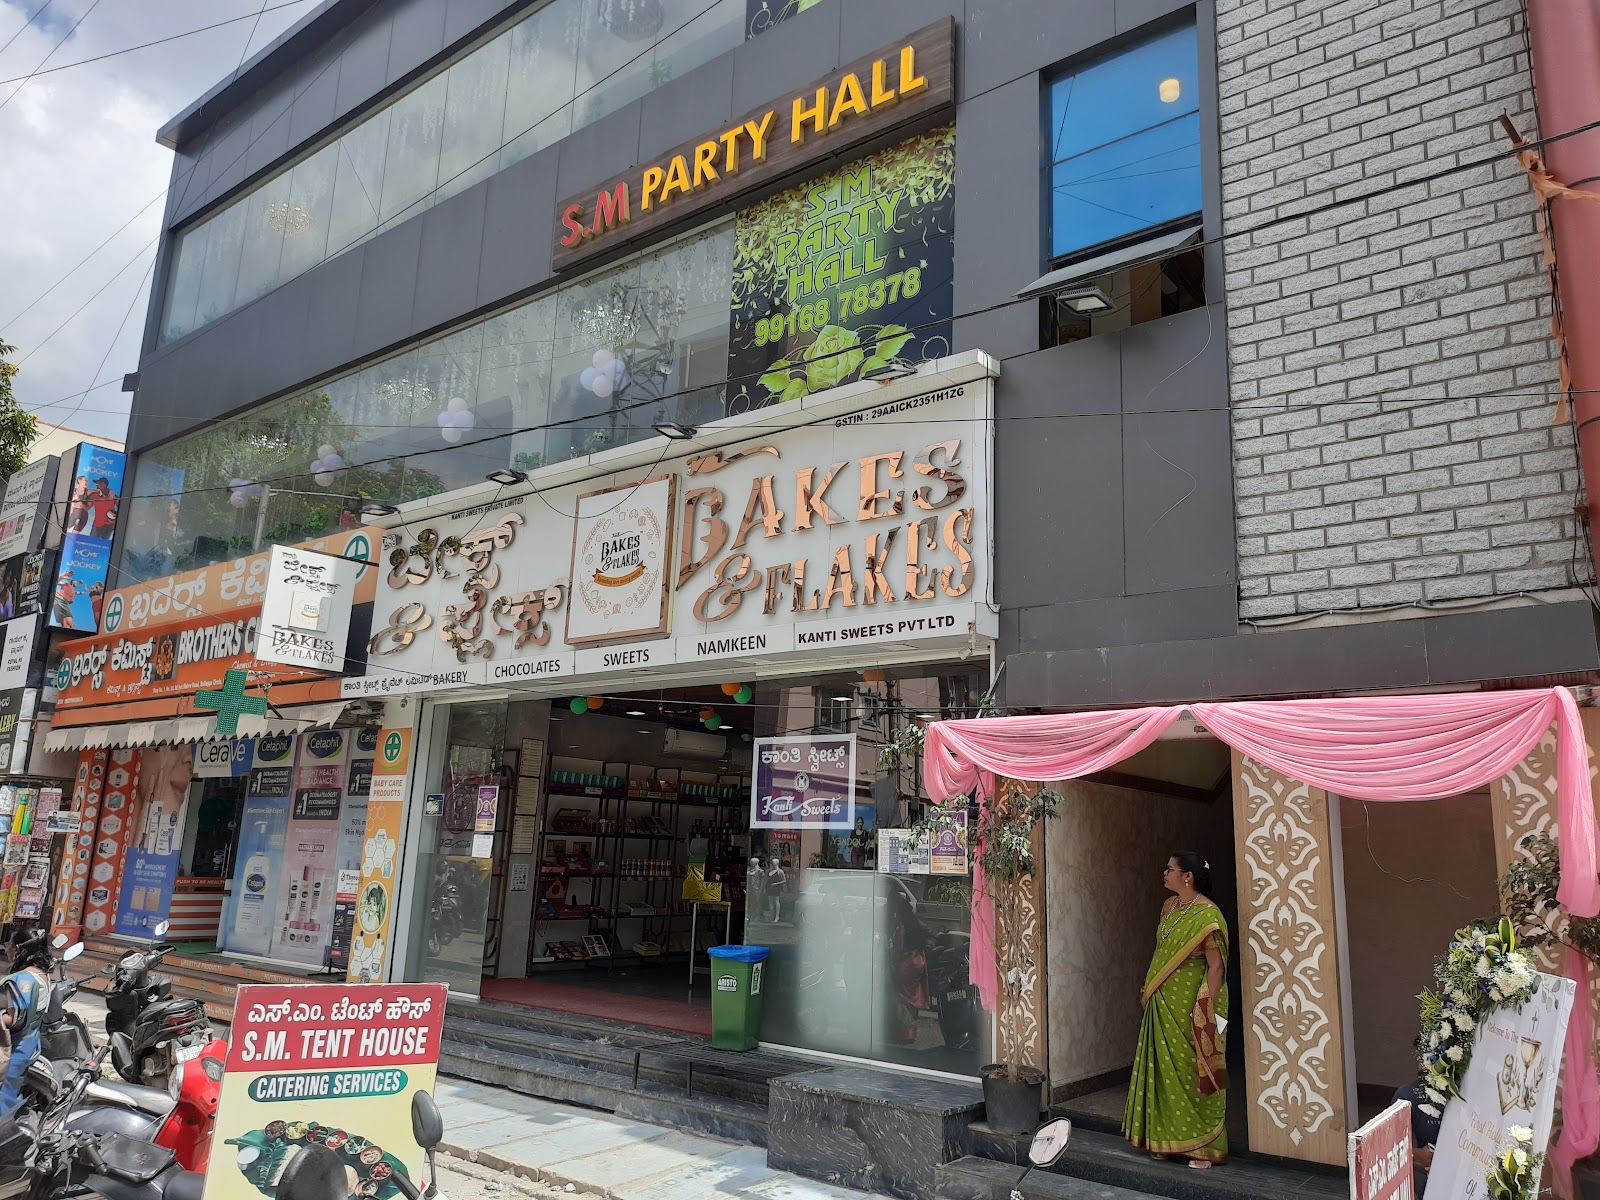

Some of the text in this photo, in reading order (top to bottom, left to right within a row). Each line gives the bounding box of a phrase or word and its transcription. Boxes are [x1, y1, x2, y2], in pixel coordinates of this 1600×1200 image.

[560, 45, 929, 248] S.M PARTY HALL
[806, 163, 874, 220] S.M
[777, 187, 903, 268] PARTY
[787, 239, 891, 304] HALL
[754, 267, 922, 347] 99168 78378
[835, 412, 864, 428] GSTIN
[83, 466, 118, 478] JOCKEY
[451, 497, 524, 520] KANTI SWEETS PRIVATE LIMITED
[675, 439, 968, 592] BAKES
[601, 535, 640, 563] BAKES
[602, 549, 640, 571] & FLAKES
[66, 560, 102, 571] JOCKEY
[692, 507, 975, 622] & FLAKES
[272, 630, 334, 651] BAKES
[798, 614, 955, 644] KANTI SWEETS PVT LTD
[177, 620, 244, 665] BROTHERS
[697, 634, 766, 656] NAMKEEN
[292, 649, 335, 664] FLAKES
[603, 649, 650, 667] SWEETS
[433, 670, 468, 686] BAKERY
[494, 659, 561, 678] CHOCOLATES
[261, 740, 288, 753] Cetaphil
[310, 736, 339, 750] Cetaphil
[360, 733, 377, 743] Cetap
[200, 740, 246, 763] CeraVe
[761, 745, 845, 771] ಕಾಂತಿ ಸ್ವೀಟ್ಸ್
[762, 795, 842, 816] Kanti Sweets
[180, 960, 222, 971] LIFESTYLE PRODUCTS
[248, 997, 431, 1024] ಎಸ್.ಎಂ. ಟೆಂಟ್ ಹೌಸ್
[241, 1026, 429, 1062] S.M. TENT HOUSE
[256, 1071, 401, 1099] CATERING SERVICES
